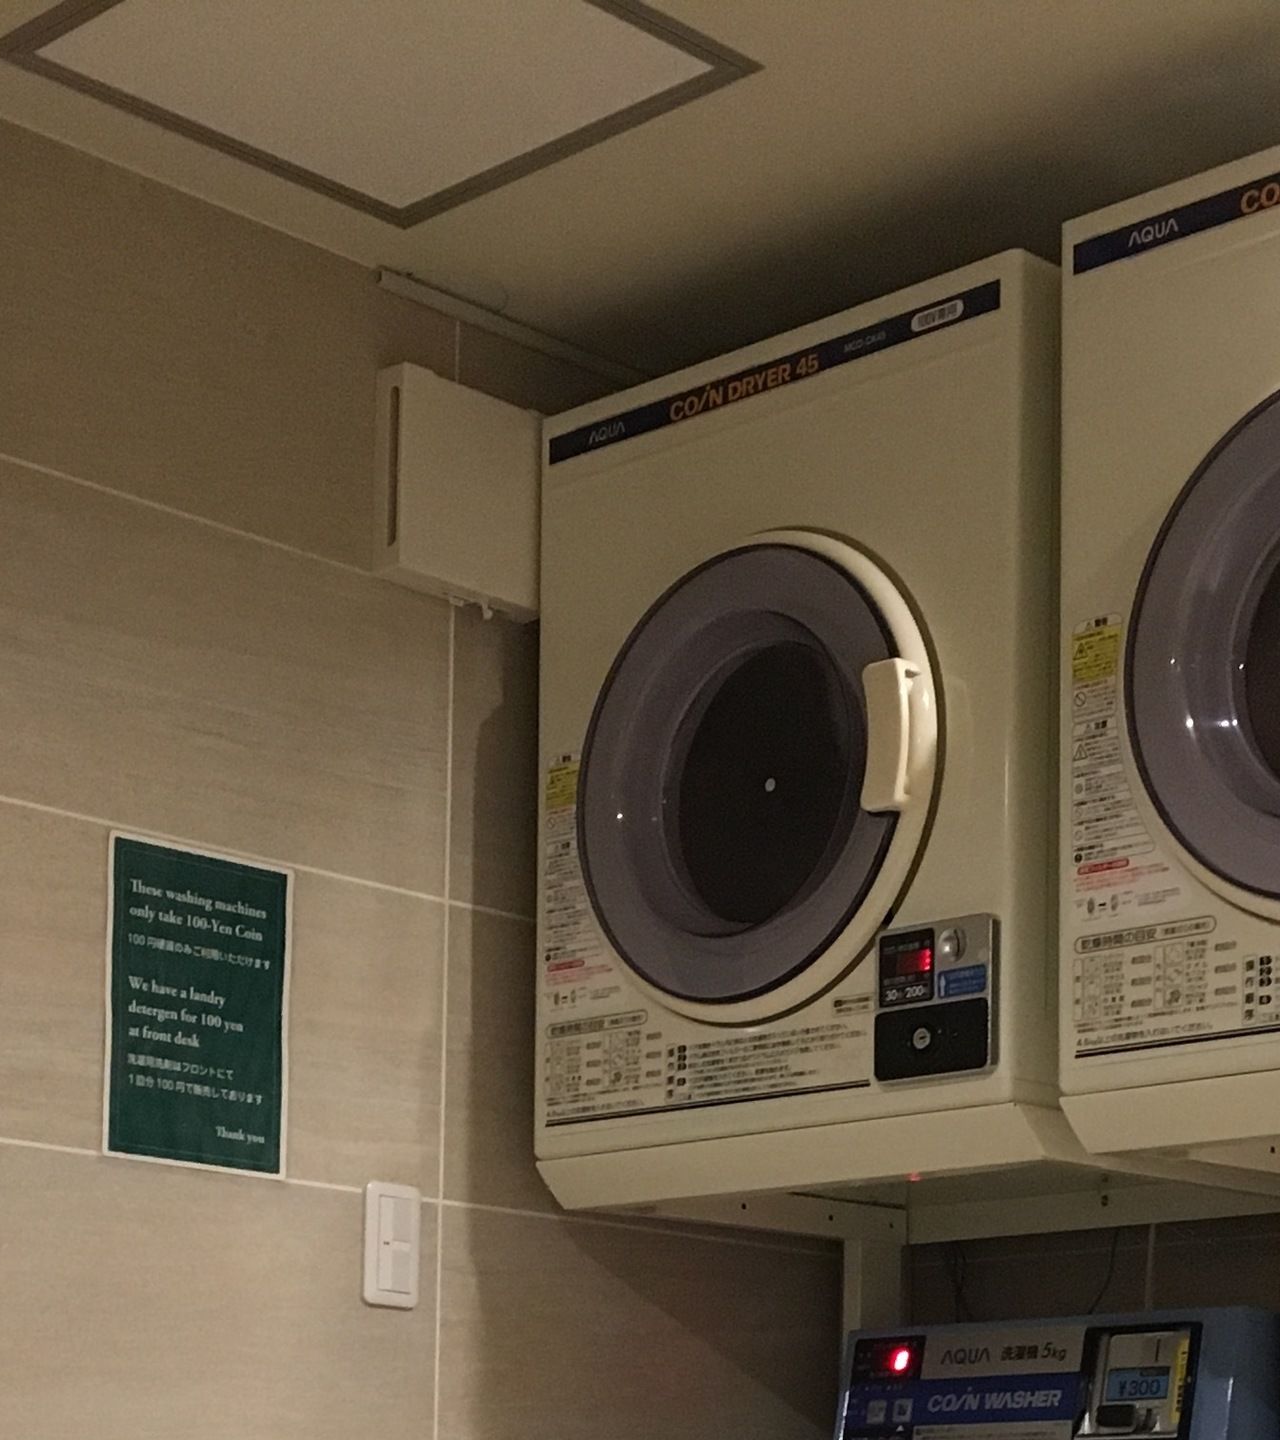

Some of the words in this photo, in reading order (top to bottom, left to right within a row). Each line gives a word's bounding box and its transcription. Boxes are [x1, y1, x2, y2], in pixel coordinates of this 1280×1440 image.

[1127, 217, 1180, 248] AQUA
[587, 420, 627, 445] AQUA
[728, 362, 792, 402] DRYER
[796, 353, 820, 378] 45
[130, 878, 163, 898] These
[166, 890, 213, 912] washing
[215, 900, 267, 920] machines
[129, 905, 155, 923] only
[158, 909, 184, 925] take
[187, 914, 233, 936] 100-Yen
[235, 924, 264, 942] Coin
[128, 975, 149, 992] We
[151, 979, 178, 998] have
[180, 989, 187, 999] a
[189, 986, 227, 1009] landry
[128, 1000, 178, 1022] detergen
[181, 1008, 198, 1024] for
[201, 1013, 222, 1028] 100
[224, 1020, 244, 1033] yen
[128, 1026, 140, 1037] at
[142, 1025, 172, 1044] front
[174, 1031, 200, 1048] desk
[215, 1126, 245, 1141] Thank
[247, 1132, 265, 1145] you
[940, 1347, 991, 1365] AQUA
[1041, 1341, 1067, 1361] 5kg
[984, 1389, 1063, 1410] WASHER
[1119, 1379, 1161, 1397] ¥300
